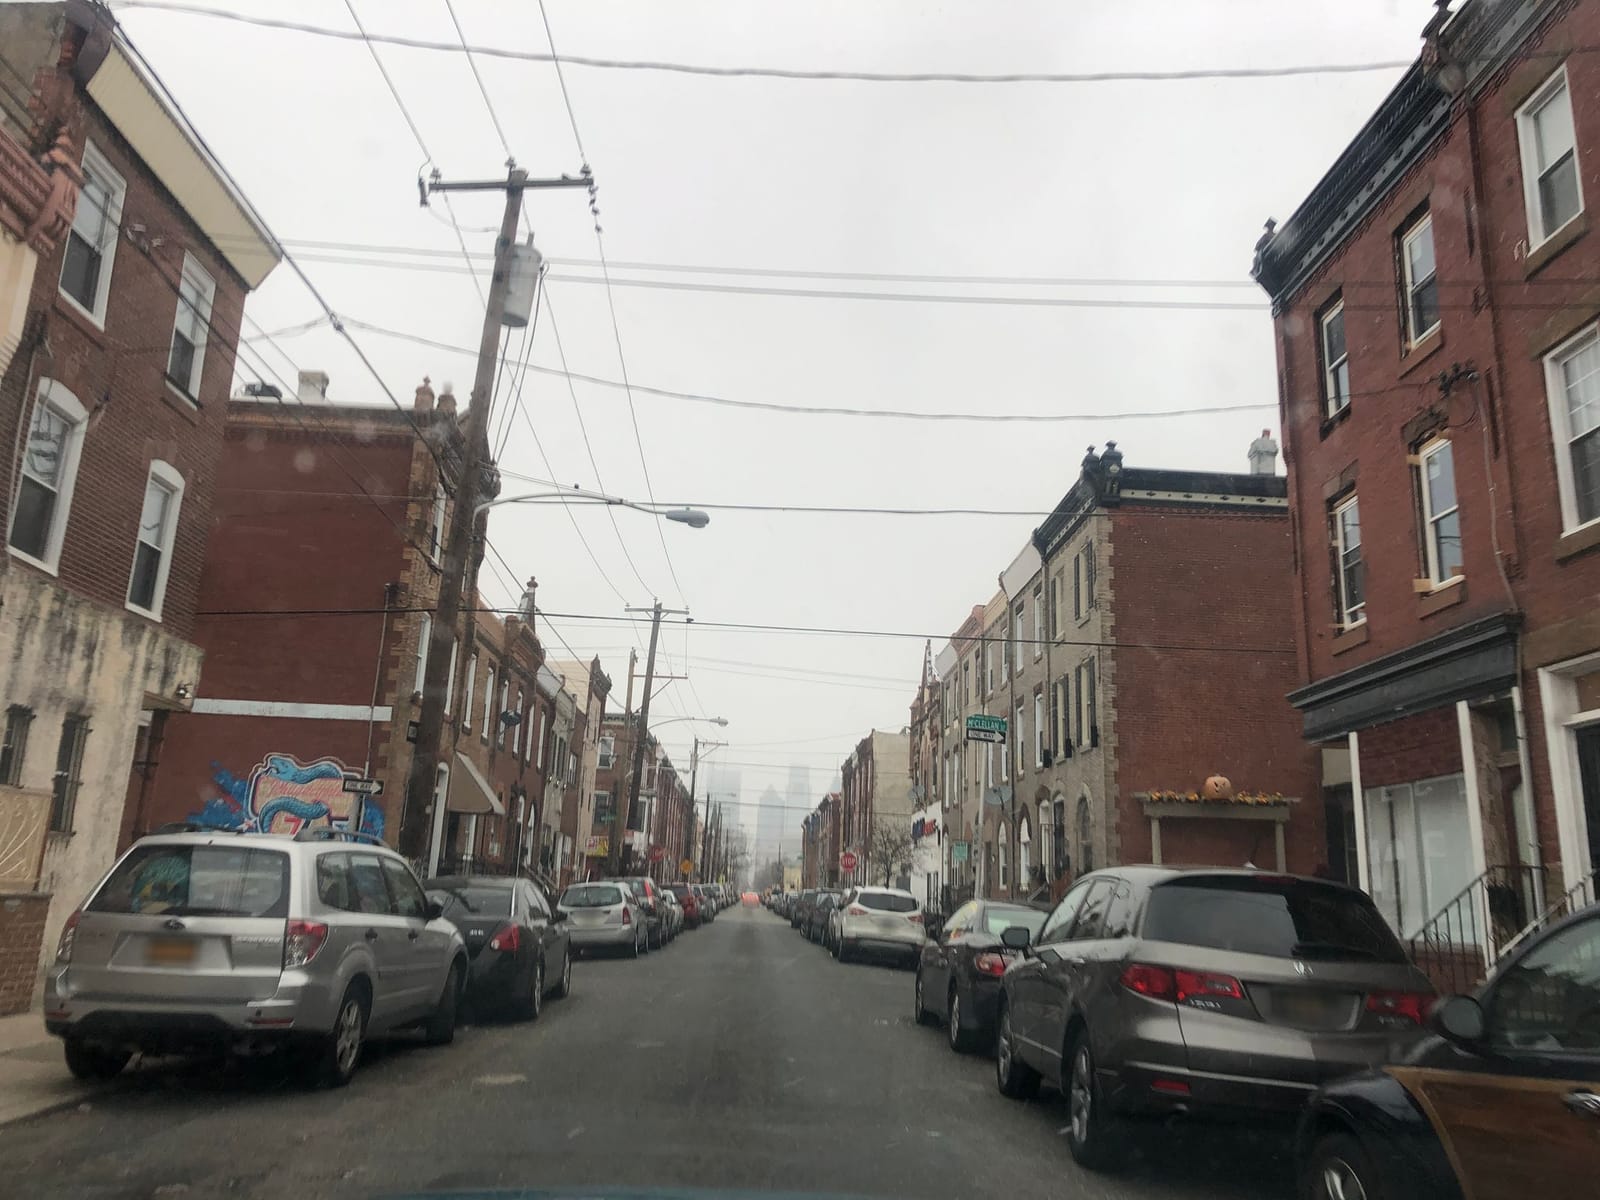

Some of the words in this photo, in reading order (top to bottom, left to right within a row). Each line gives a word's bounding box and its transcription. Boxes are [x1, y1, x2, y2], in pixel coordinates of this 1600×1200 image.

[345, 781, 358, 791] ONE
[360, 782, 373, 791] WAY
[840, 856, 856, 865] STOP
